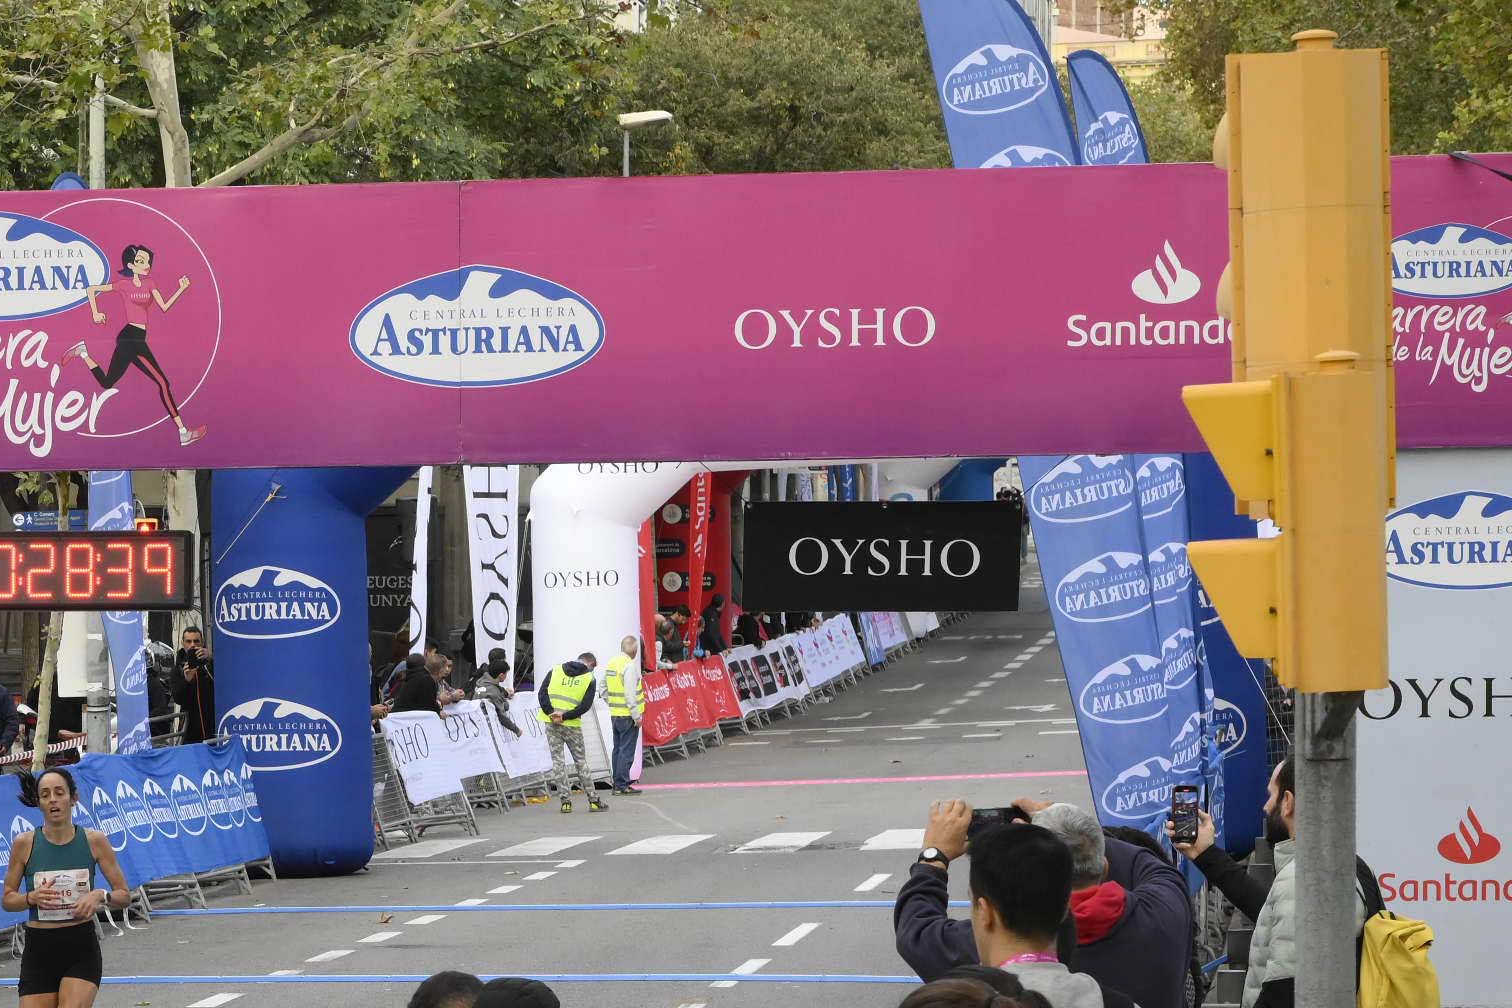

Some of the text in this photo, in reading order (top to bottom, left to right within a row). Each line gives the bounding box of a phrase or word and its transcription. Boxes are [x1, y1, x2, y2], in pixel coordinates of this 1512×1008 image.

[13, 247, 84, 260] LECHERA
[1406, 249, 1457, 257] CENTRAL
[409, 306, 577, 320] CENTRAL LECHERA
[734, 305, 937, 349] OYSHO
[1392, 304, 1488, 333] arrera
[369, 313, 585, 356] ASTURIANA
[1067, 313, 1233, 348] Santand
[1415, 334, 1434, 361] la
[1429, 328, 1512, 393] Muje
[1413, 526, 1480, 536] CENTRAL
[788, 537, 981, 577] OYSHO
[1386, 529, 1512, 566] ASTURI
[543, 569, 620, 589] OYSHO
[219, 595, 331, 623] ASTURIANA
[231, 590, 327, 600] CENTRAL LECHERA
[561, 675, 581, 688] Life
[1358, 676, 1512, 720] OYSH
[223, 726, 332, 752] TURIANA
[233, 722, 328, 731] CENTRAL LECHERA
[1379, 872, 1512, 903] Santan
